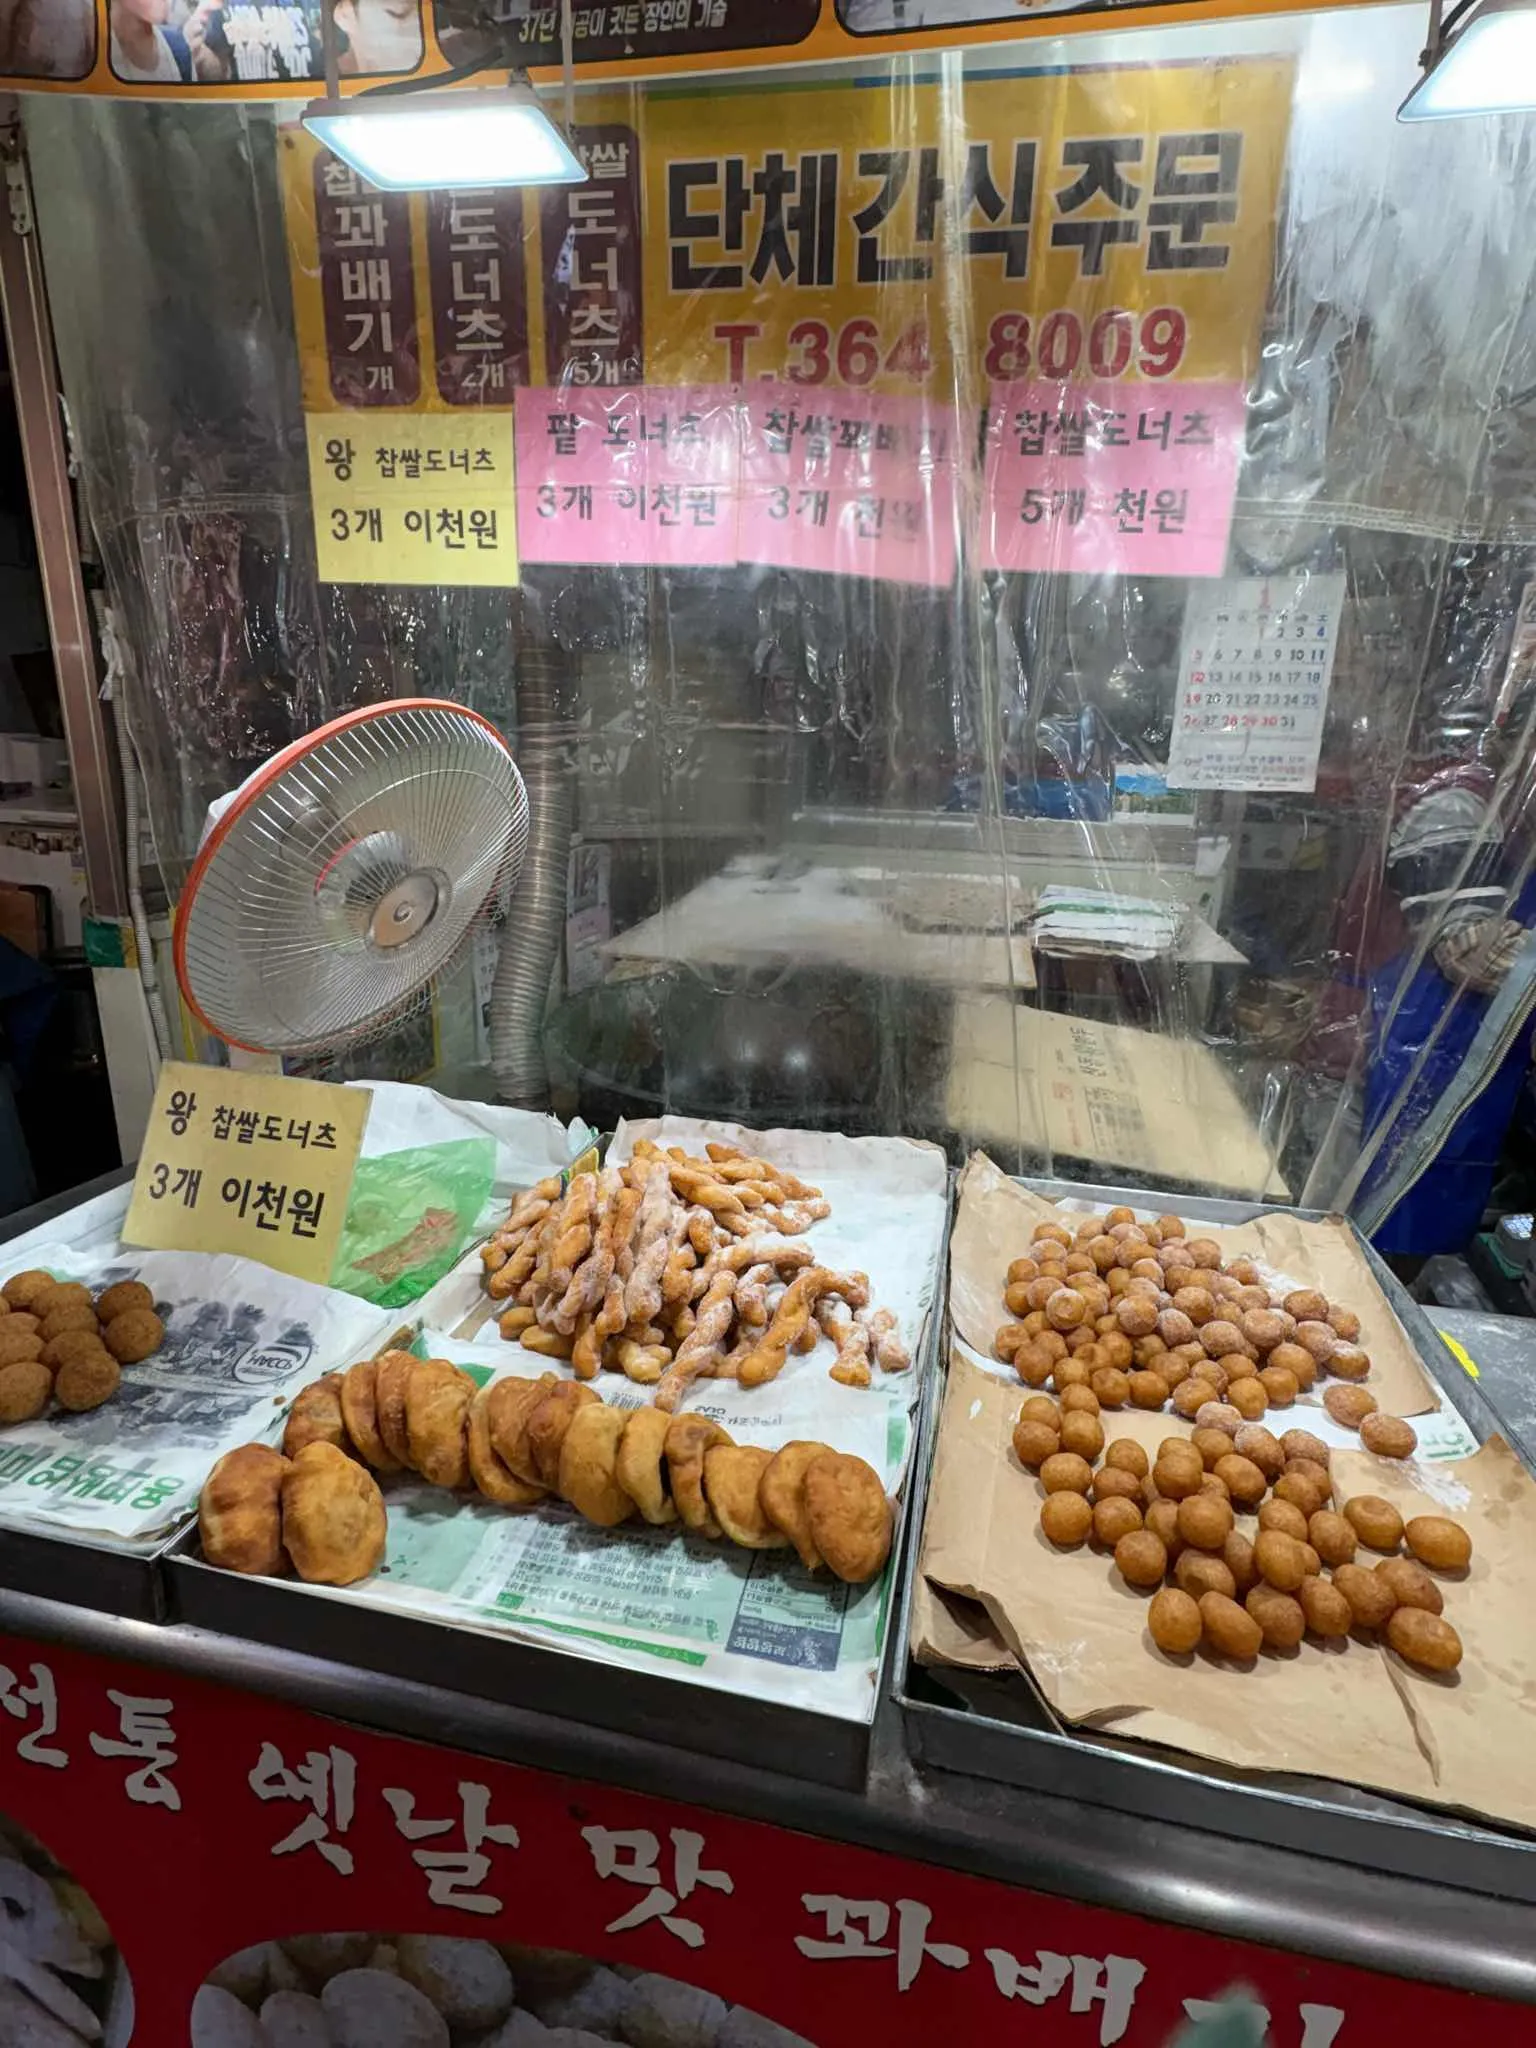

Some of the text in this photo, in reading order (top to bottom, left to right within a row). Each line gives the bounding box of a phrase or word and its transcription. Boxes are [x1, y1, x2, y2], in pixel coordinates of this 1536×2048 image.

[560, 7, 605, 40] 공이
[546, 411, 708, 456] 팥 도너츠
[1014, 409, 1215, 456] 찹쌀도너츠
[324, 438, 496, 481] 왕 찹쌀도너츠
[536, 484, 718, 527] 3개 이천원
[767, 486, 830, 527] 3개
[1021, 487, 1188, 534] 5개 천원
[330, 508, 499, 550] 3개 이천원
[1296, 626, 1305, 638] 3
[1317, 626, 1325, 638] 4
[1234, 648, 1243, 660] 7
[1274, 648, 1282, 660] 9
[1290, 649, 1305, 660] 10
[1311, 649, 1325, 660] 11
[1268, 671, 1282, 682] 16
[1287, 671, 1302, 683] 17
[1307, 671, 1321, 683] 18
[1225, 694, 1240, 705] 21
[1244, 694, 1261, 705] 22
[1283, 694, 1299, 705] 24
[1281, 716, 1296, 727] 31
[166, 1090, 338, 1150] 왕 찹쌀도너츠
[149, 1162, 326, 1239] 3개 이천원
[579, 1823, 735, 1949] 맛
